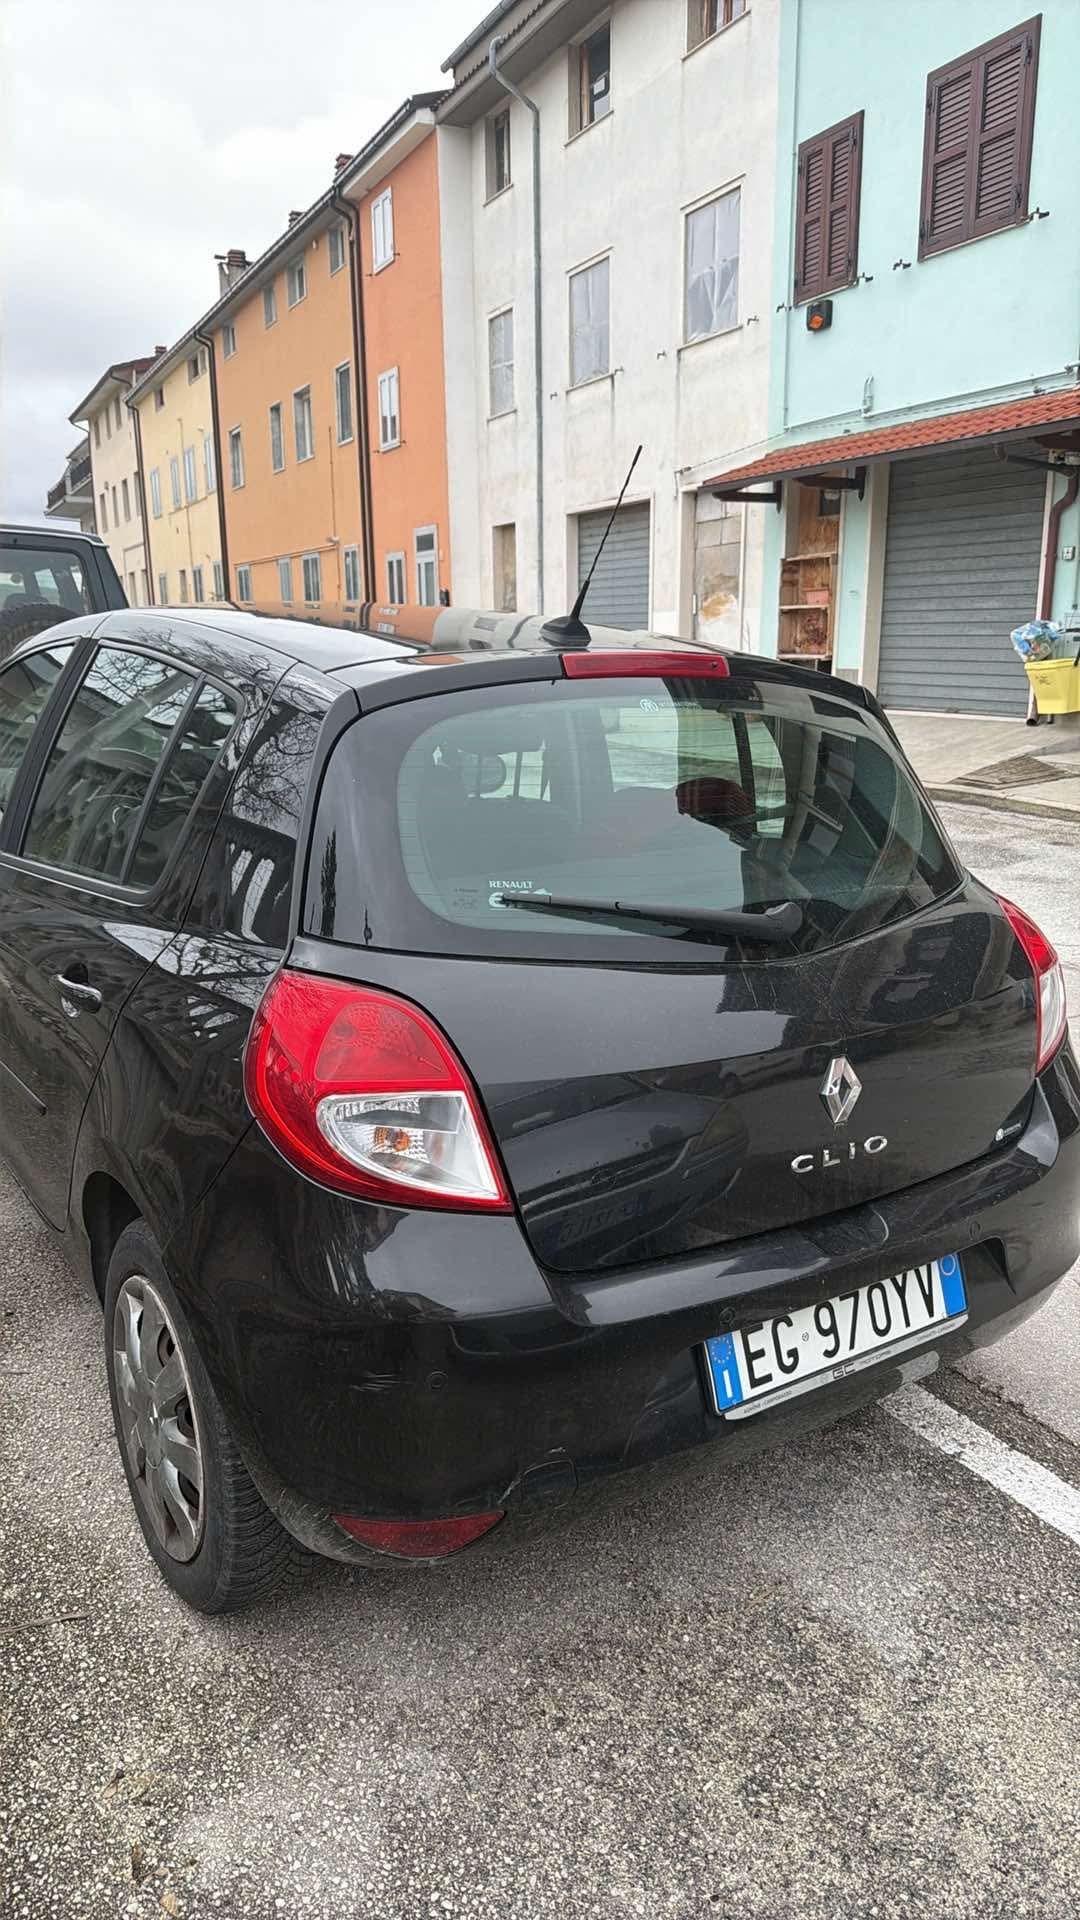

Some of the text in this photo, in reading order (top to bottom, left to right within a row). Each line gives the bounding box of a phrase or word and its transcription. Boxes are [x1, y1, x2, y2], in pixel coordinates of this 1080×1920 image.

[489, 880, 533, 889] RENAULT
[790, 1135, 888, 1173] CLIO
[740, 1264, 934, 1389] EG 970YV
[722, 1369, 733, 1398] I
